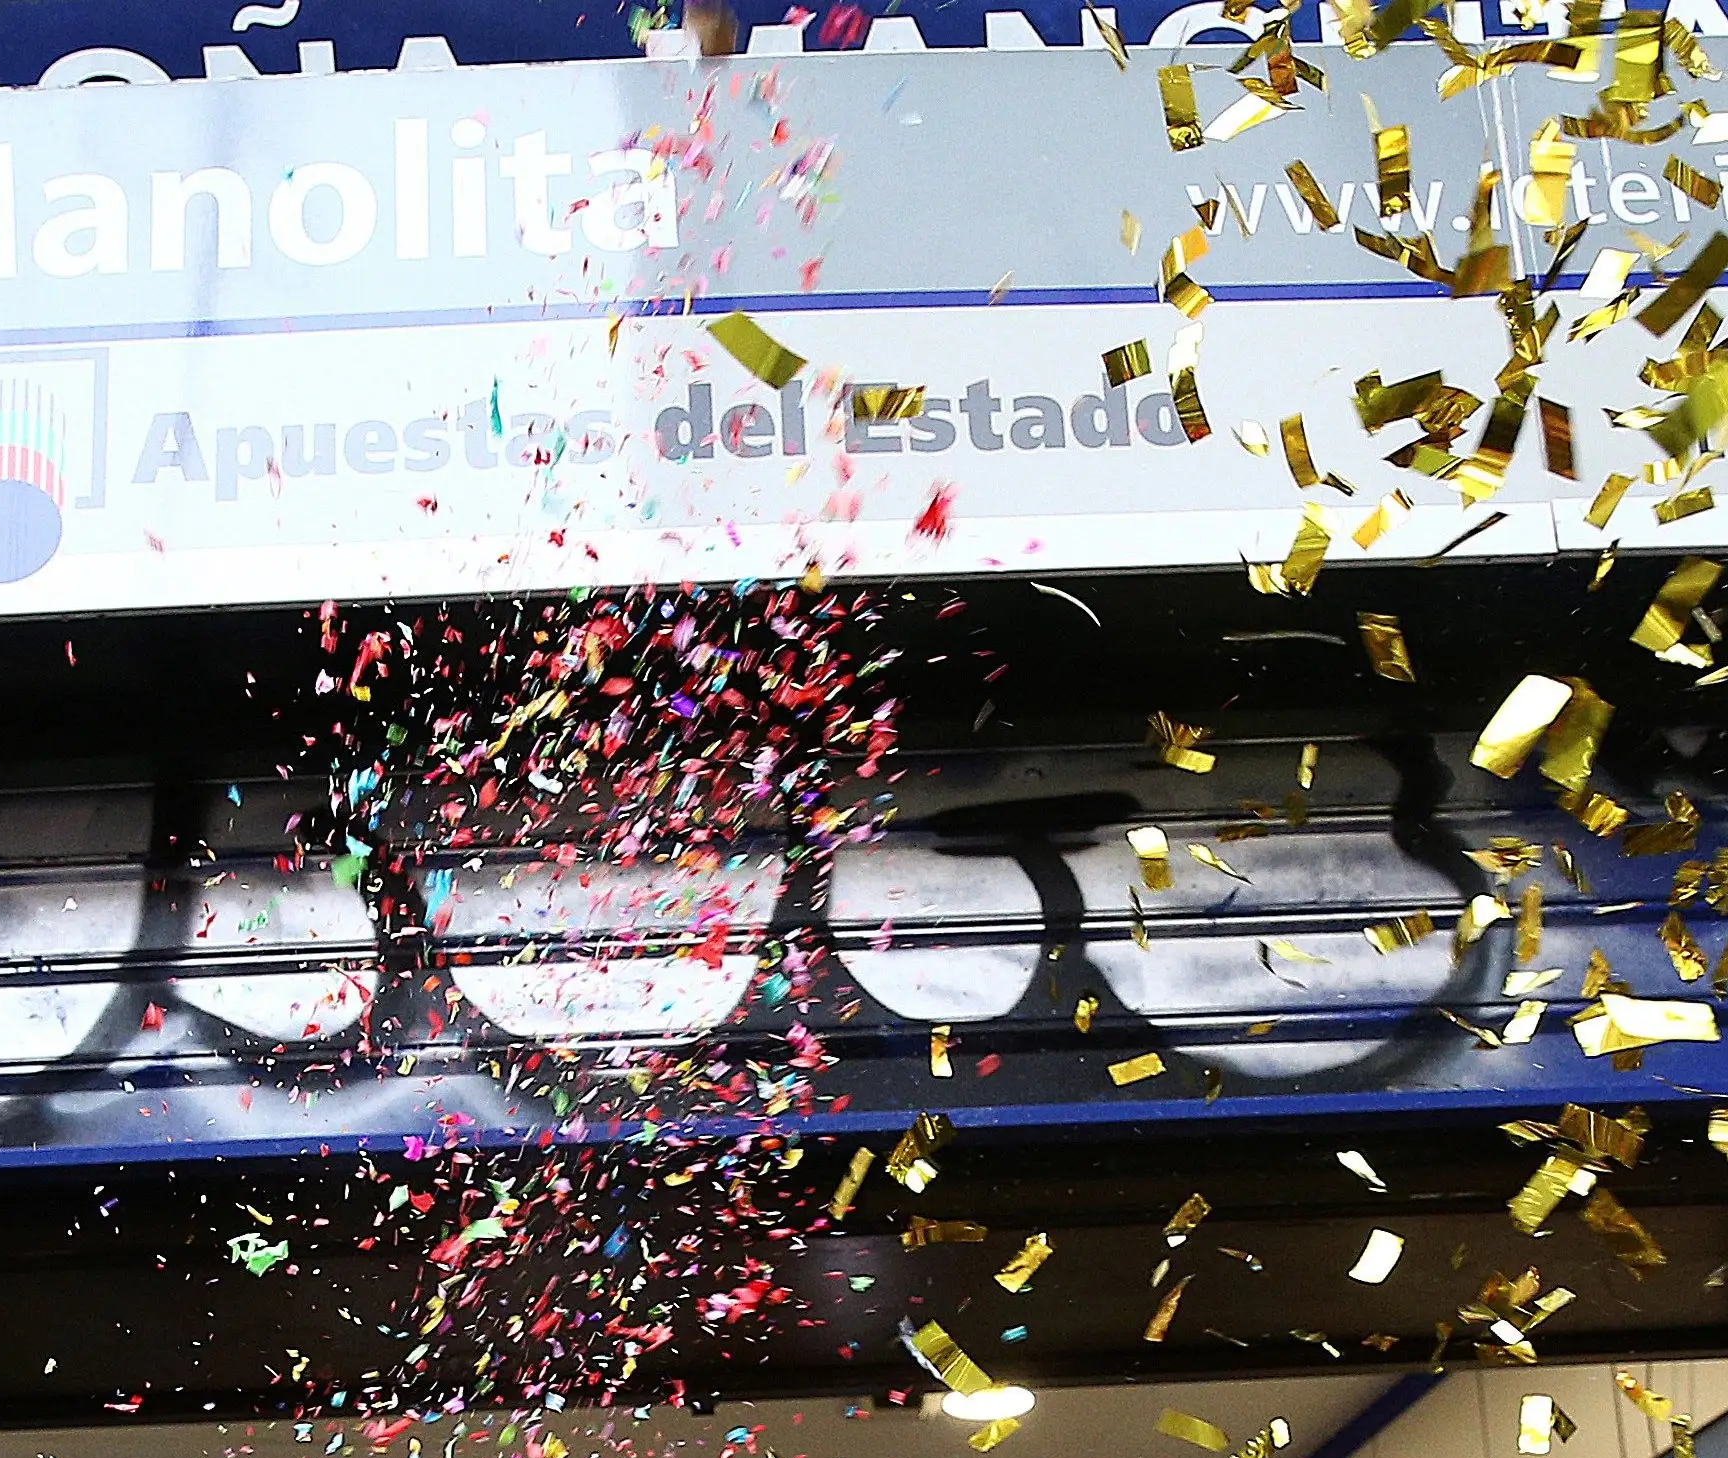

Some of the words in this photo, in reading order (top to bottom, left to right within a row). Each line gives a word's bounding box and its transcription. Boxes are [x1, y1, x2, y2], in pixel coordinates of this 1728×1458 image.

[133, 402, 615, 497] Apuestas
[656, 382, 805, 463] del
[840, 374, 1197, 454] Estado
